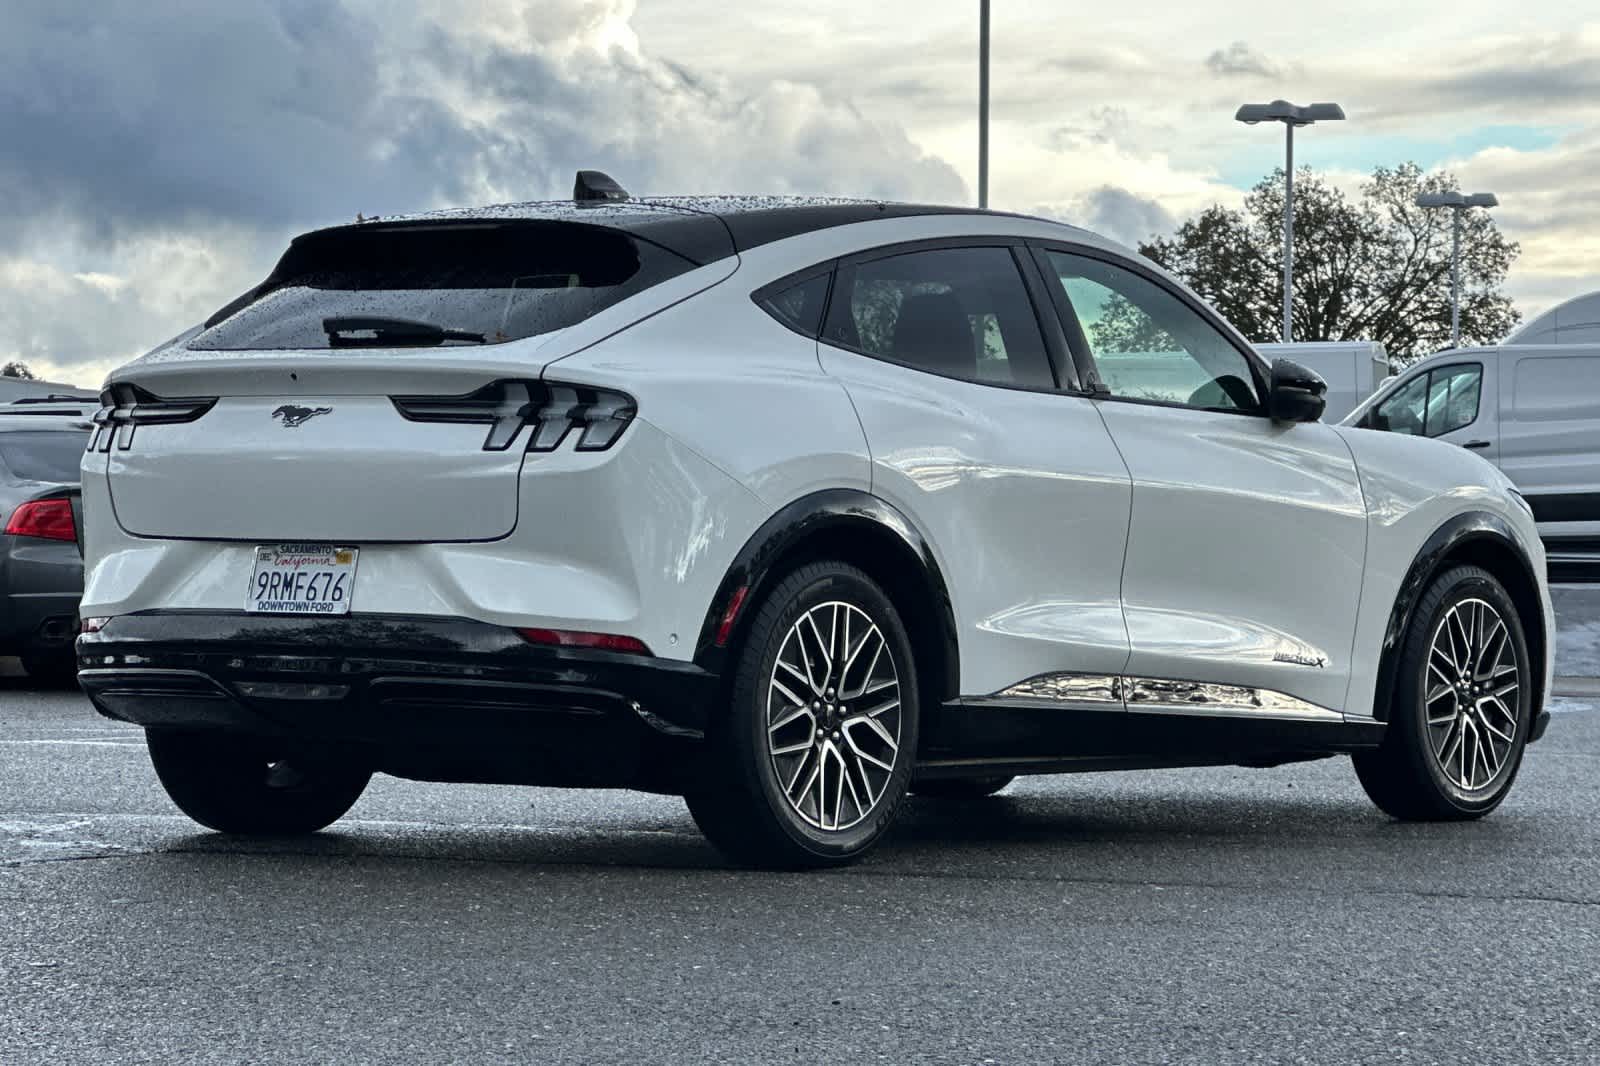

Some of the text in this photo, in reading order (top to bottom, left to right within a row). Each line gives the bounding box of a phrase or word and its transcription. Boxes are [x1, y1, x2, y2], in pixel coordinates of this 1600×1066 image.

[280, 544, 332, 555] SACRAMENTO
[273, 552, 336, 570] California
[255, 571, 347, 602] 9RMF676
[258, 601, 334, 612] DOWNTOWN FORD
